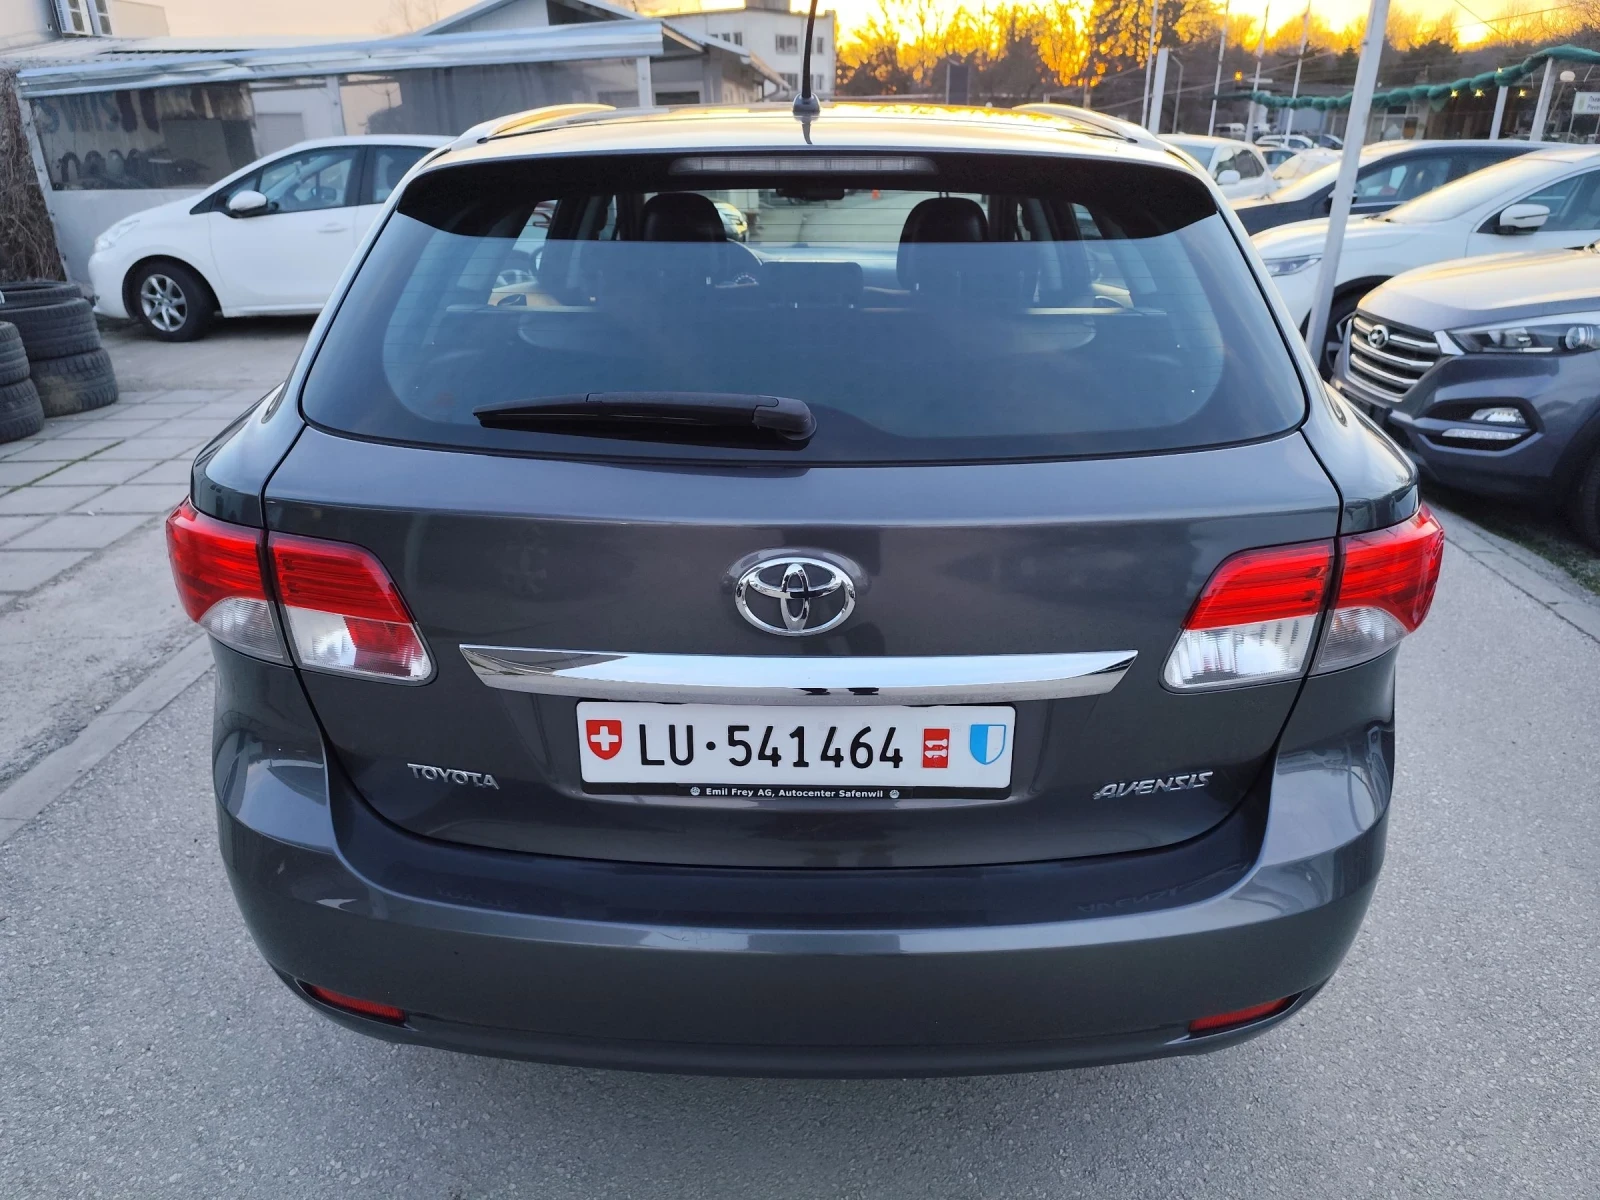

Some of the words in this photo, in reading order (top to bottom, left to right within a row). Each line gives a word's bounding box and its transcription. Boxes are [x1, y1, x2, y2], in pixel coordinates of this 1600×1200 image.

[407, 763, 500, 790] TOYOTA
[1093, 771, 1213, 800] AVENSIS
[706, 787, 728, 796] Emil
[731, 788, 754, 798] Frey
[757, 788, 775, 798] AG,
[778, 789, 836, 798] Autocenter
[839, 789, 883, 798] Safenwil
